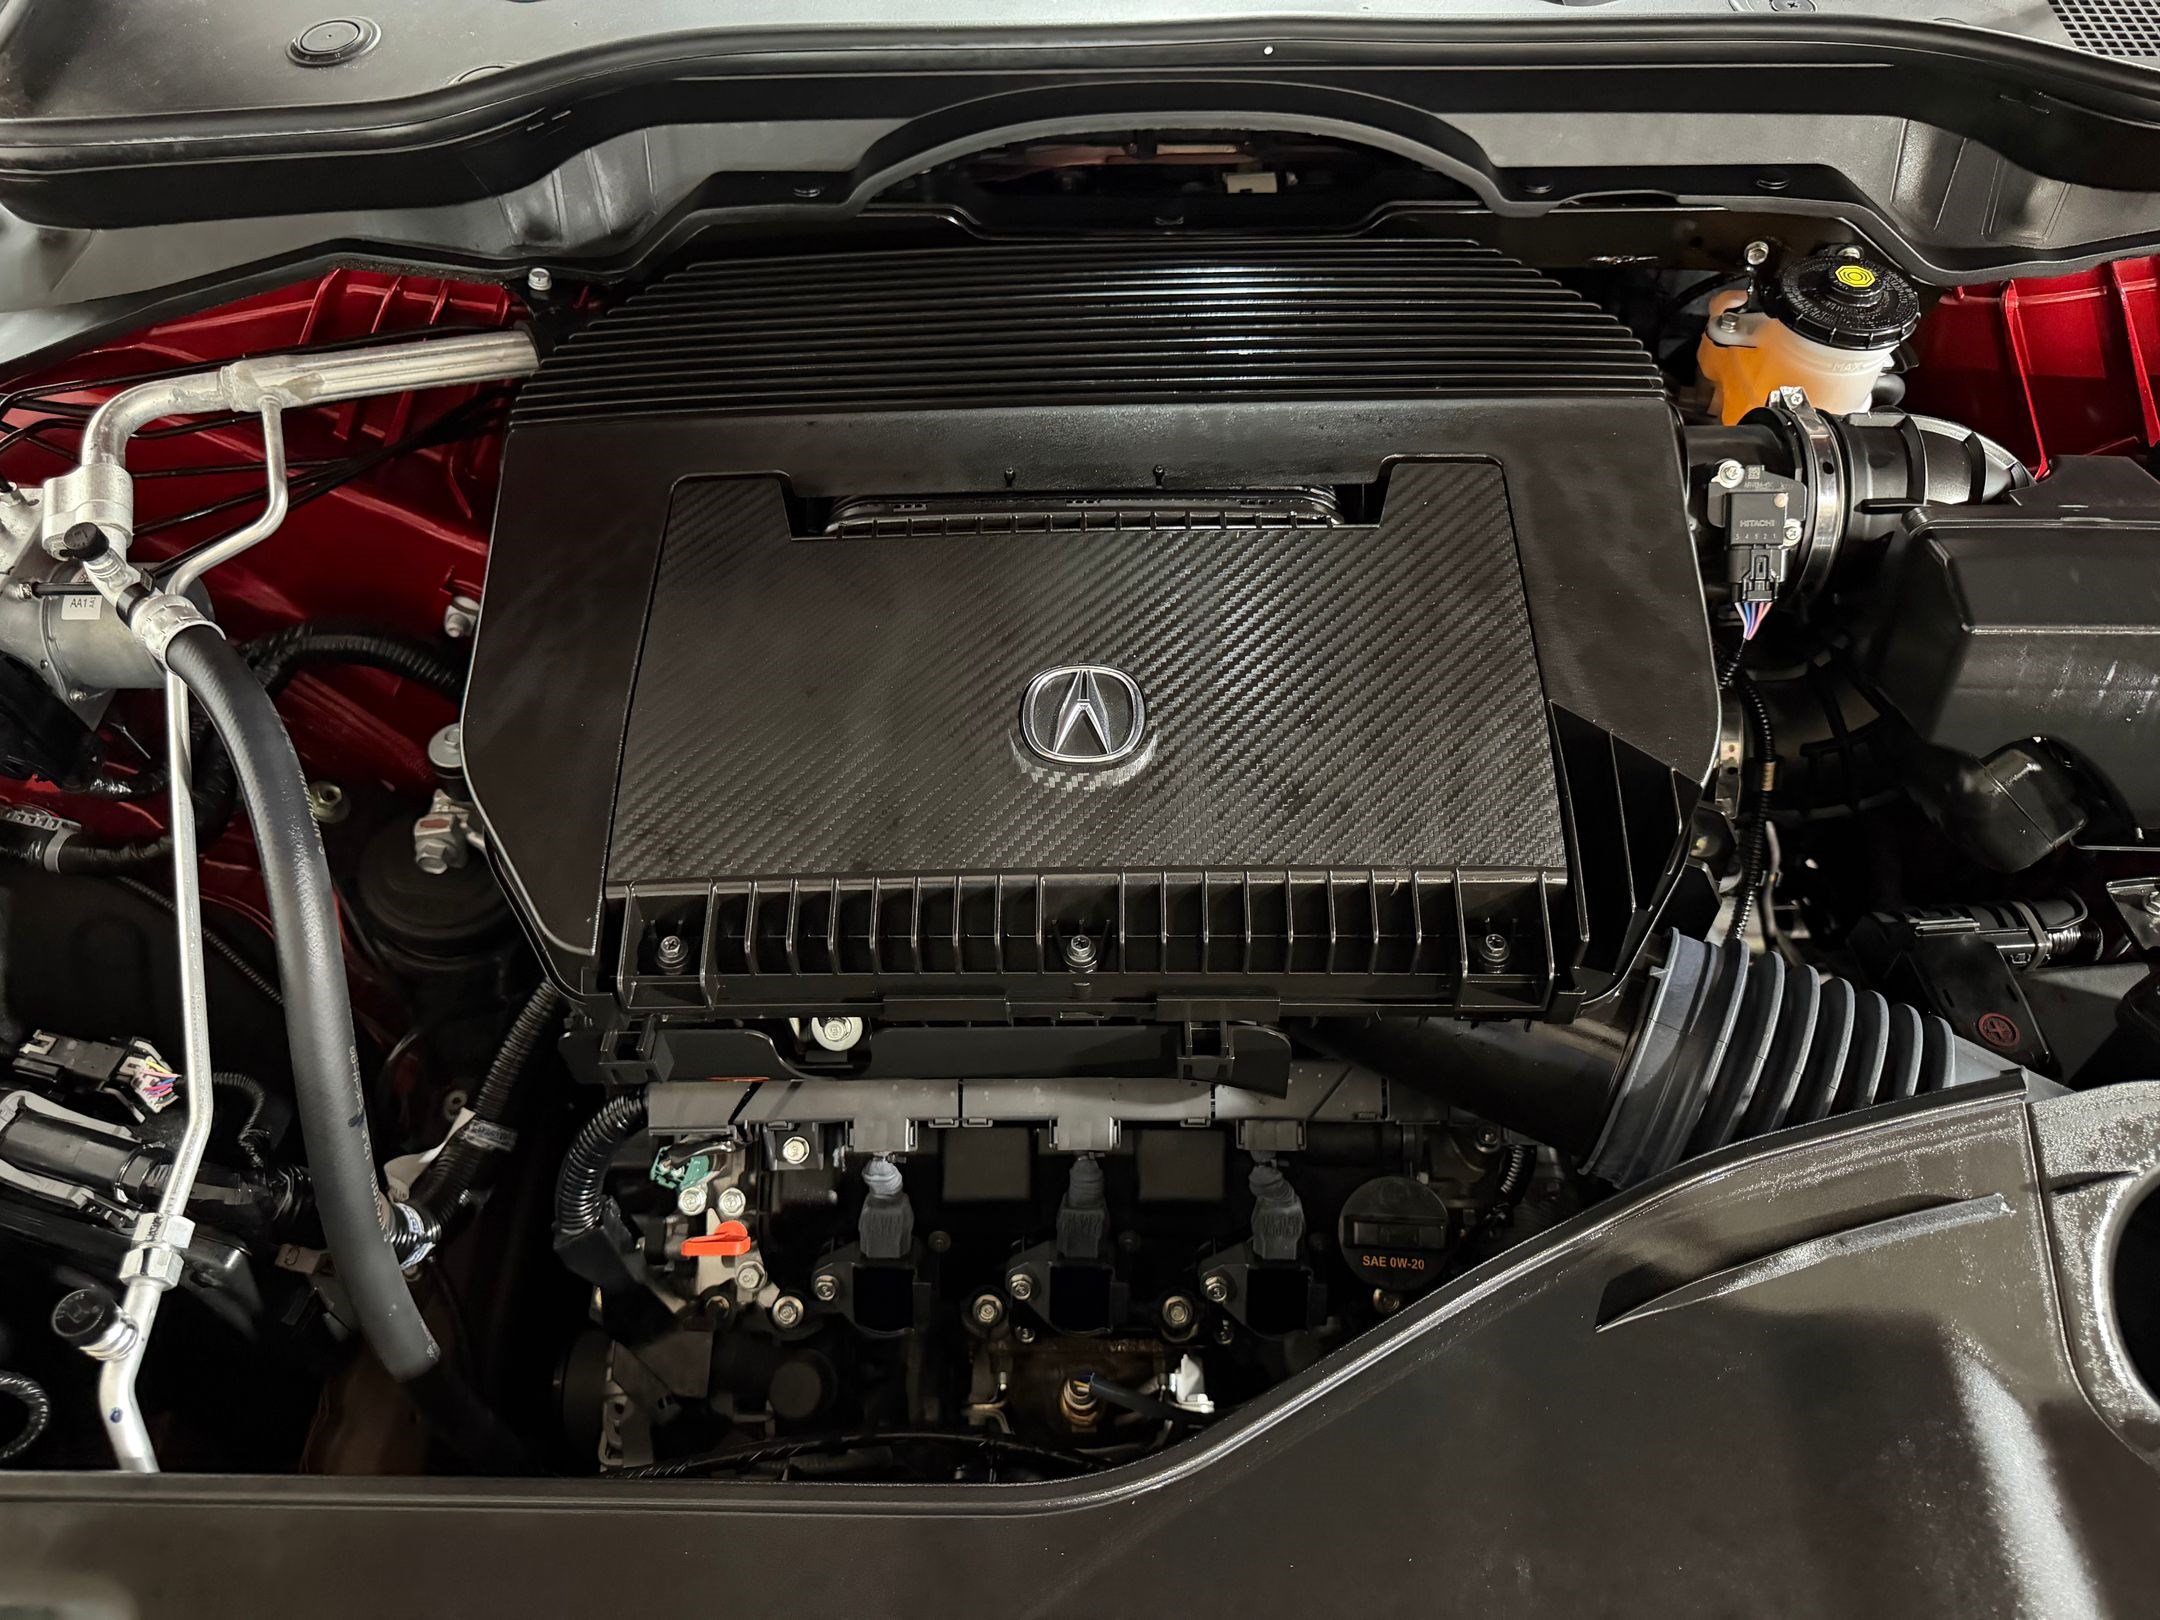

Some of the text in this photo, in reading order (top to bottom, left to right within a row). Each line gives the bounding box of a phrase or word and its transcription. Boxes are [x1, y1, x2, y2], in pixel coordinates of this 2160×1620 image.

[1739, 519, 1776, 528] HITACHI
[1362, 1255, 1425, 1270] SAE 0W-20
